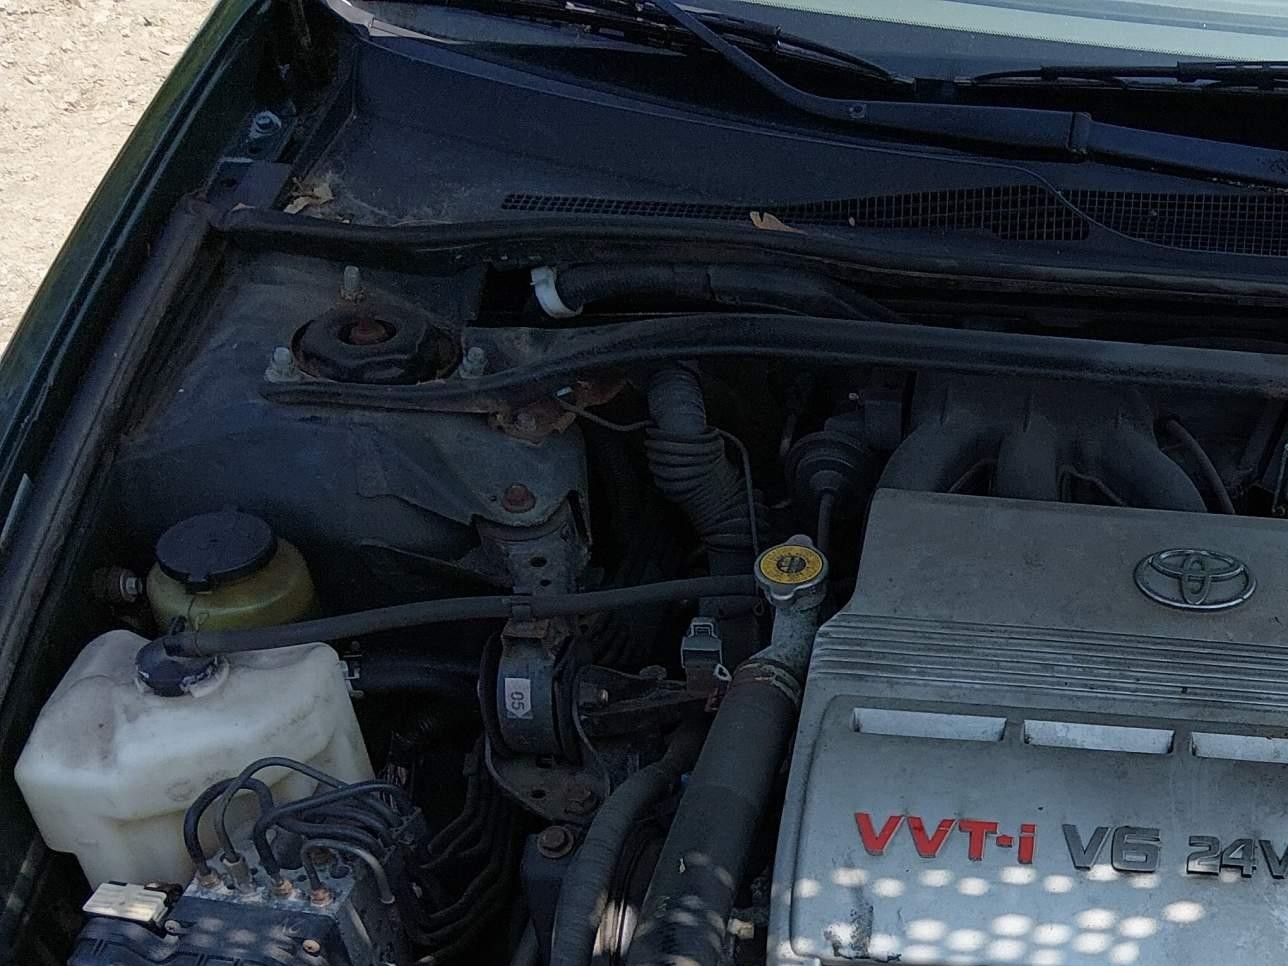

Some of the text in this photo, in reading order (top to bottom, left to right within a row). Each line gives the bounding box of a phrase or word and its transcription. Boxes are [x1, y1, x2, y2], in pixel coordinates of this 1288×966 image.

[511, 691, 525, 710] 05
[854, 813, 1037, 864] VVT-i
[1062, 824, 1162, 873] V6
